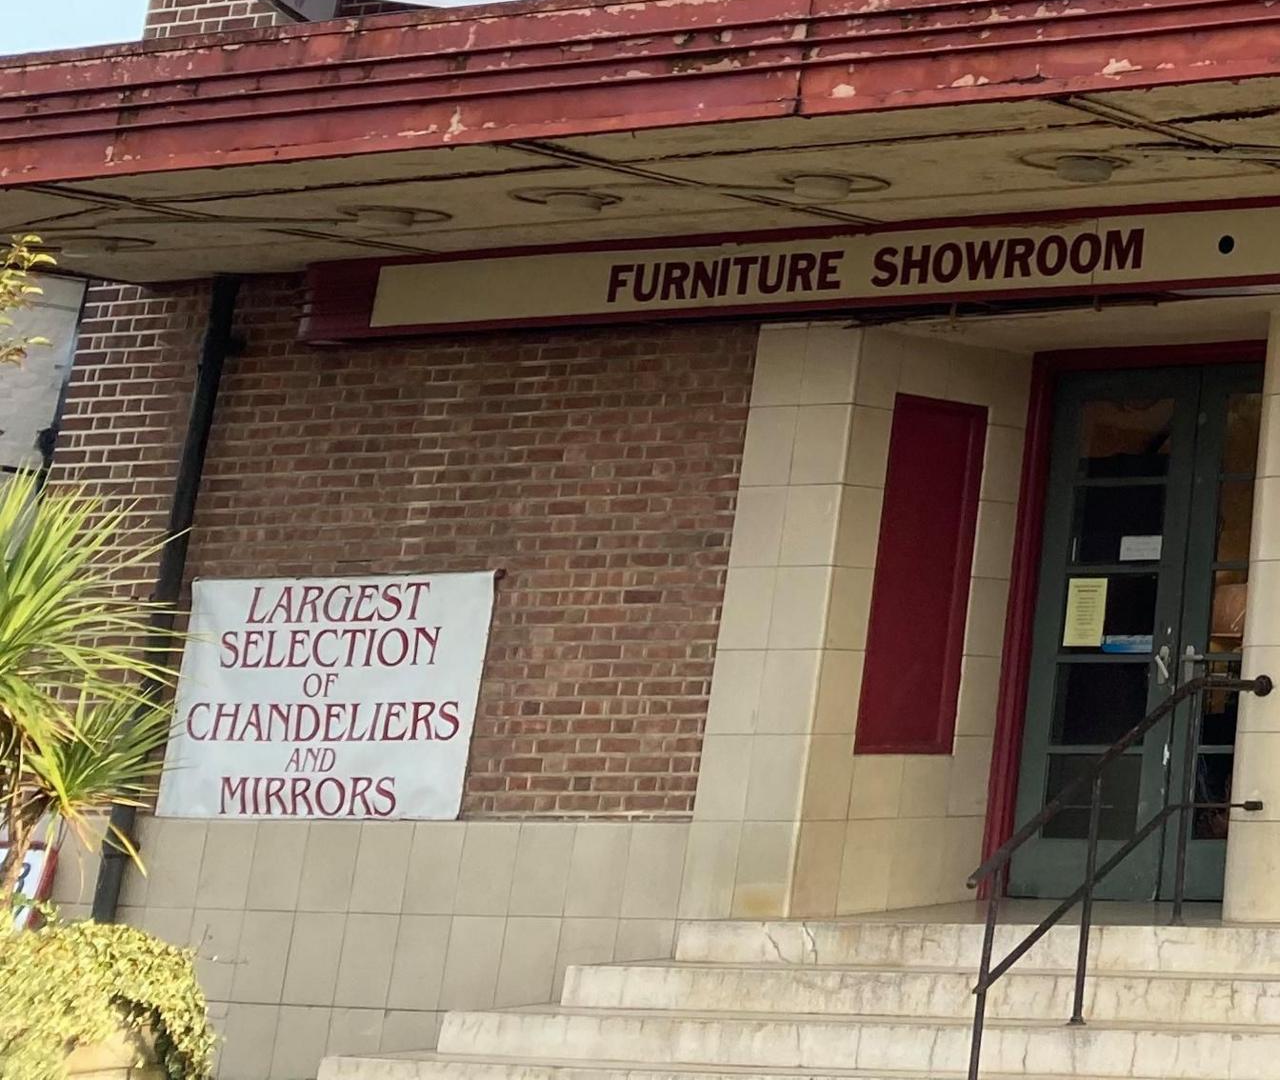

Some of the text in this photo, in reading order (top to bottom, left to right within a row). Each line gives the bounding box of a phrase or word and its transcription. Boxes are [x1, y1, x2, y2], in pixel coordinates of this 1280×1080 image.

[606, 250, 845, 303] FURNITURE
[870, 228, 1145, 287] SHOWROOM
[246, 582, 430, 624] LARGEST
[219, 626, 442, 668] SELECTION
[303, 673, 339, 697] OF
[186, 701, 460, 742] CHANDELIERS
[285, 747, 336, 772] AND
[219, 776, 396, 817] MIRRORS
